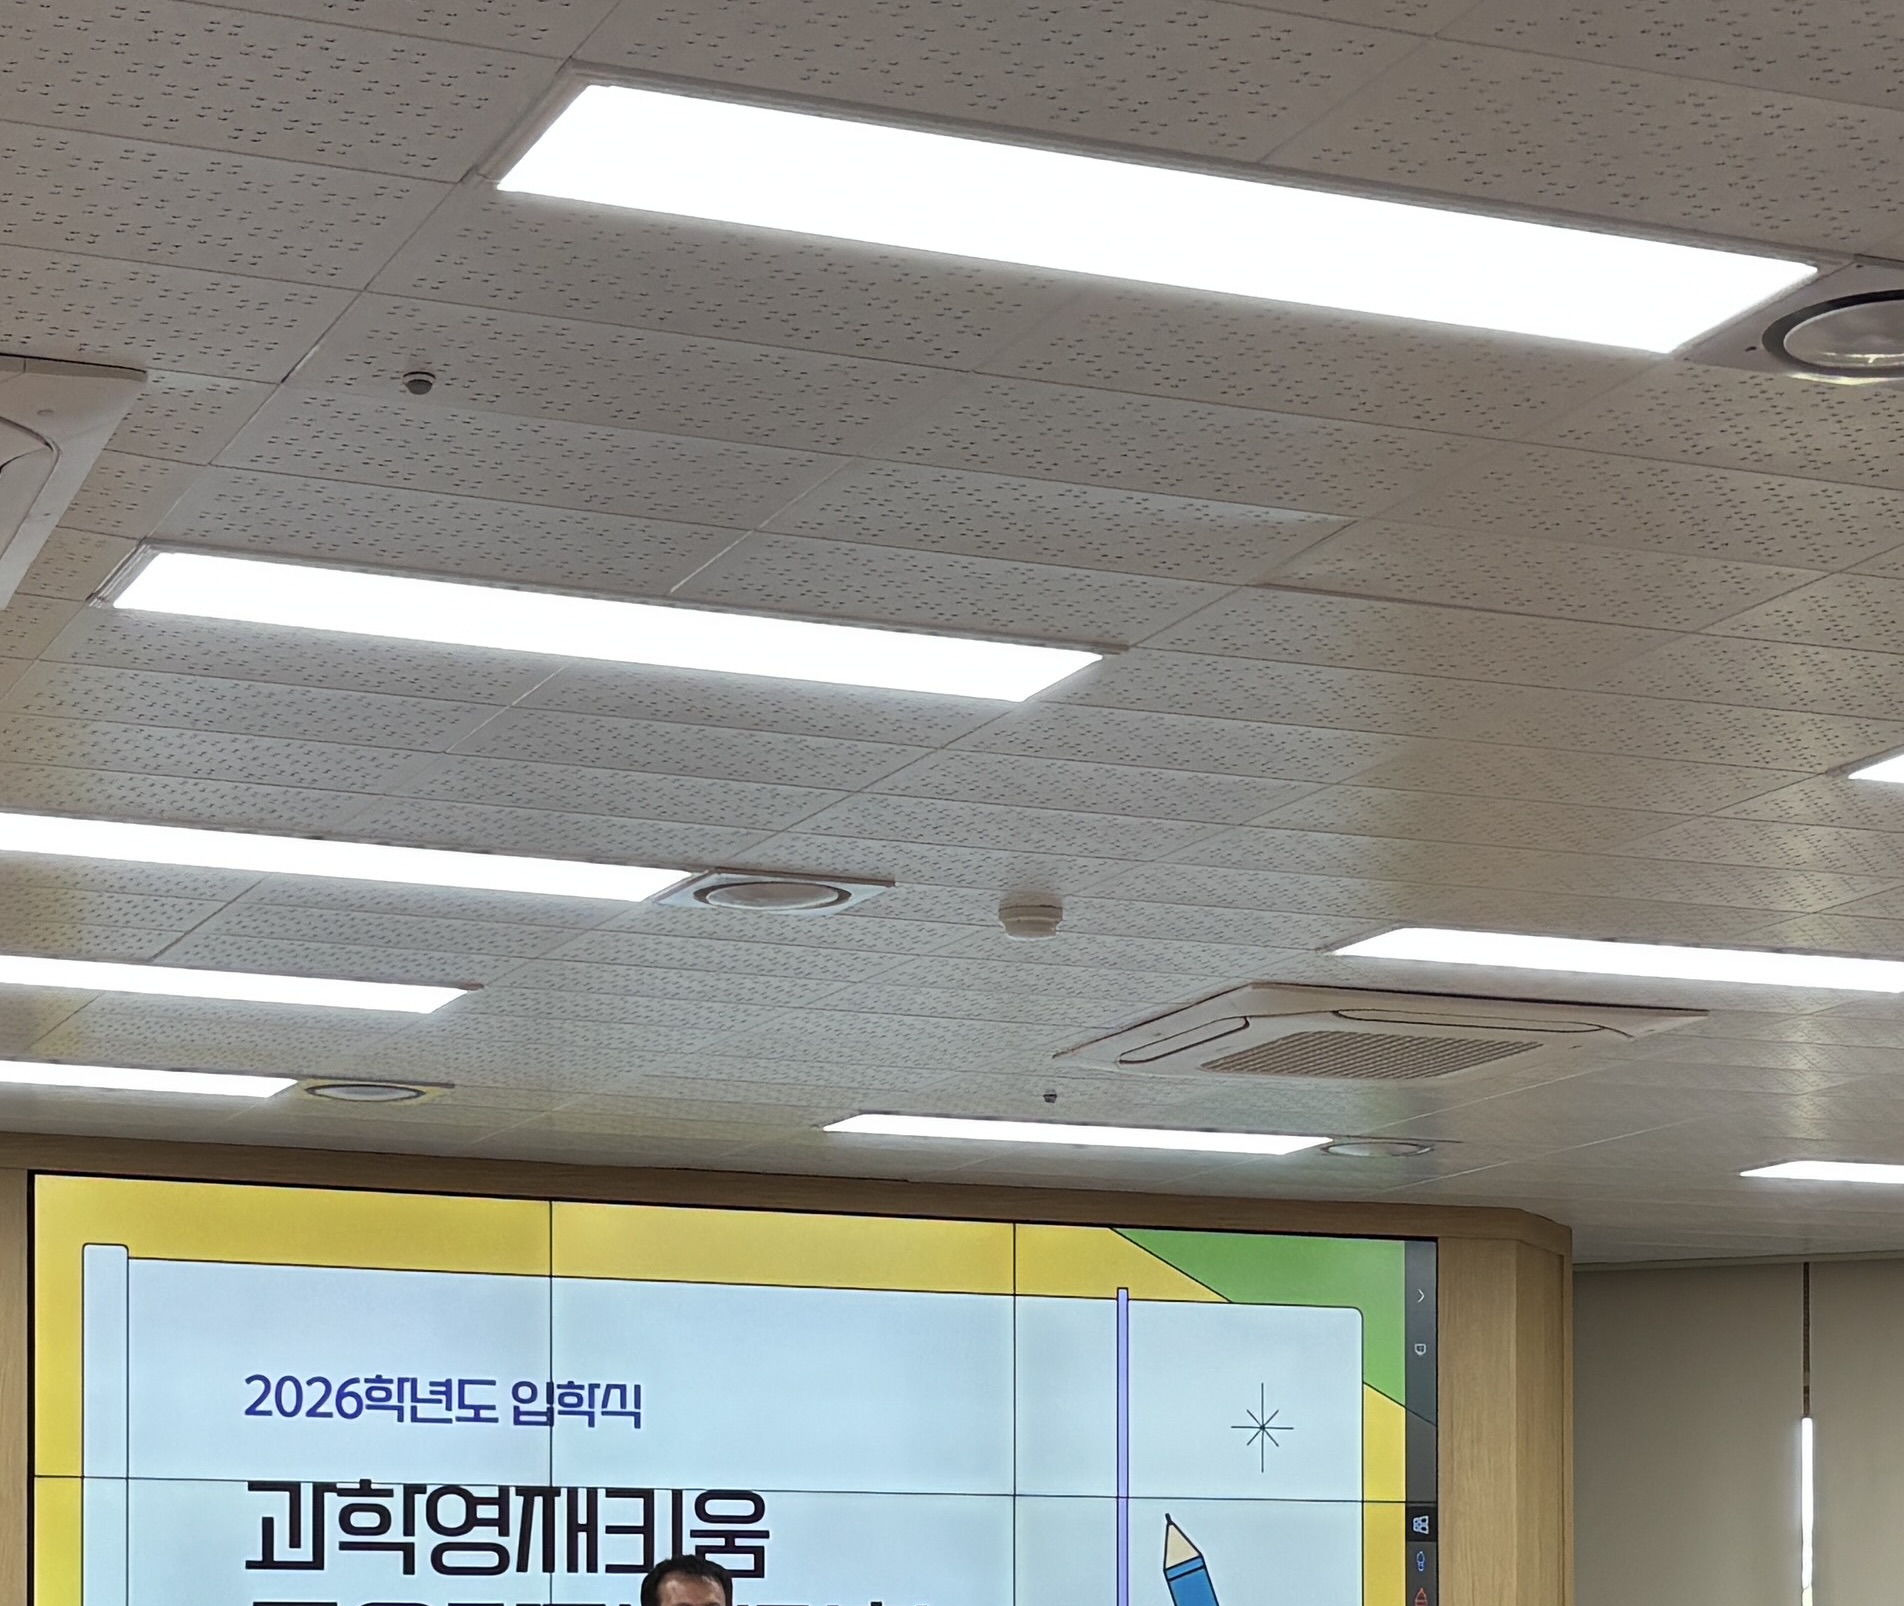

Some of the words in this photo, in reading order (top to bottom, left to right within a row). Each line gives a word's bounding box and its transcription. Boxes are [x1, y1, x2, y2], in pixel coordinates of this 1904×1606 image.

[244, 1374, 499, 1424] 2026학년도
[511, 1379, 642, 1430] 입학식
[245, 1478, 770, 1579] 과학영재키움
